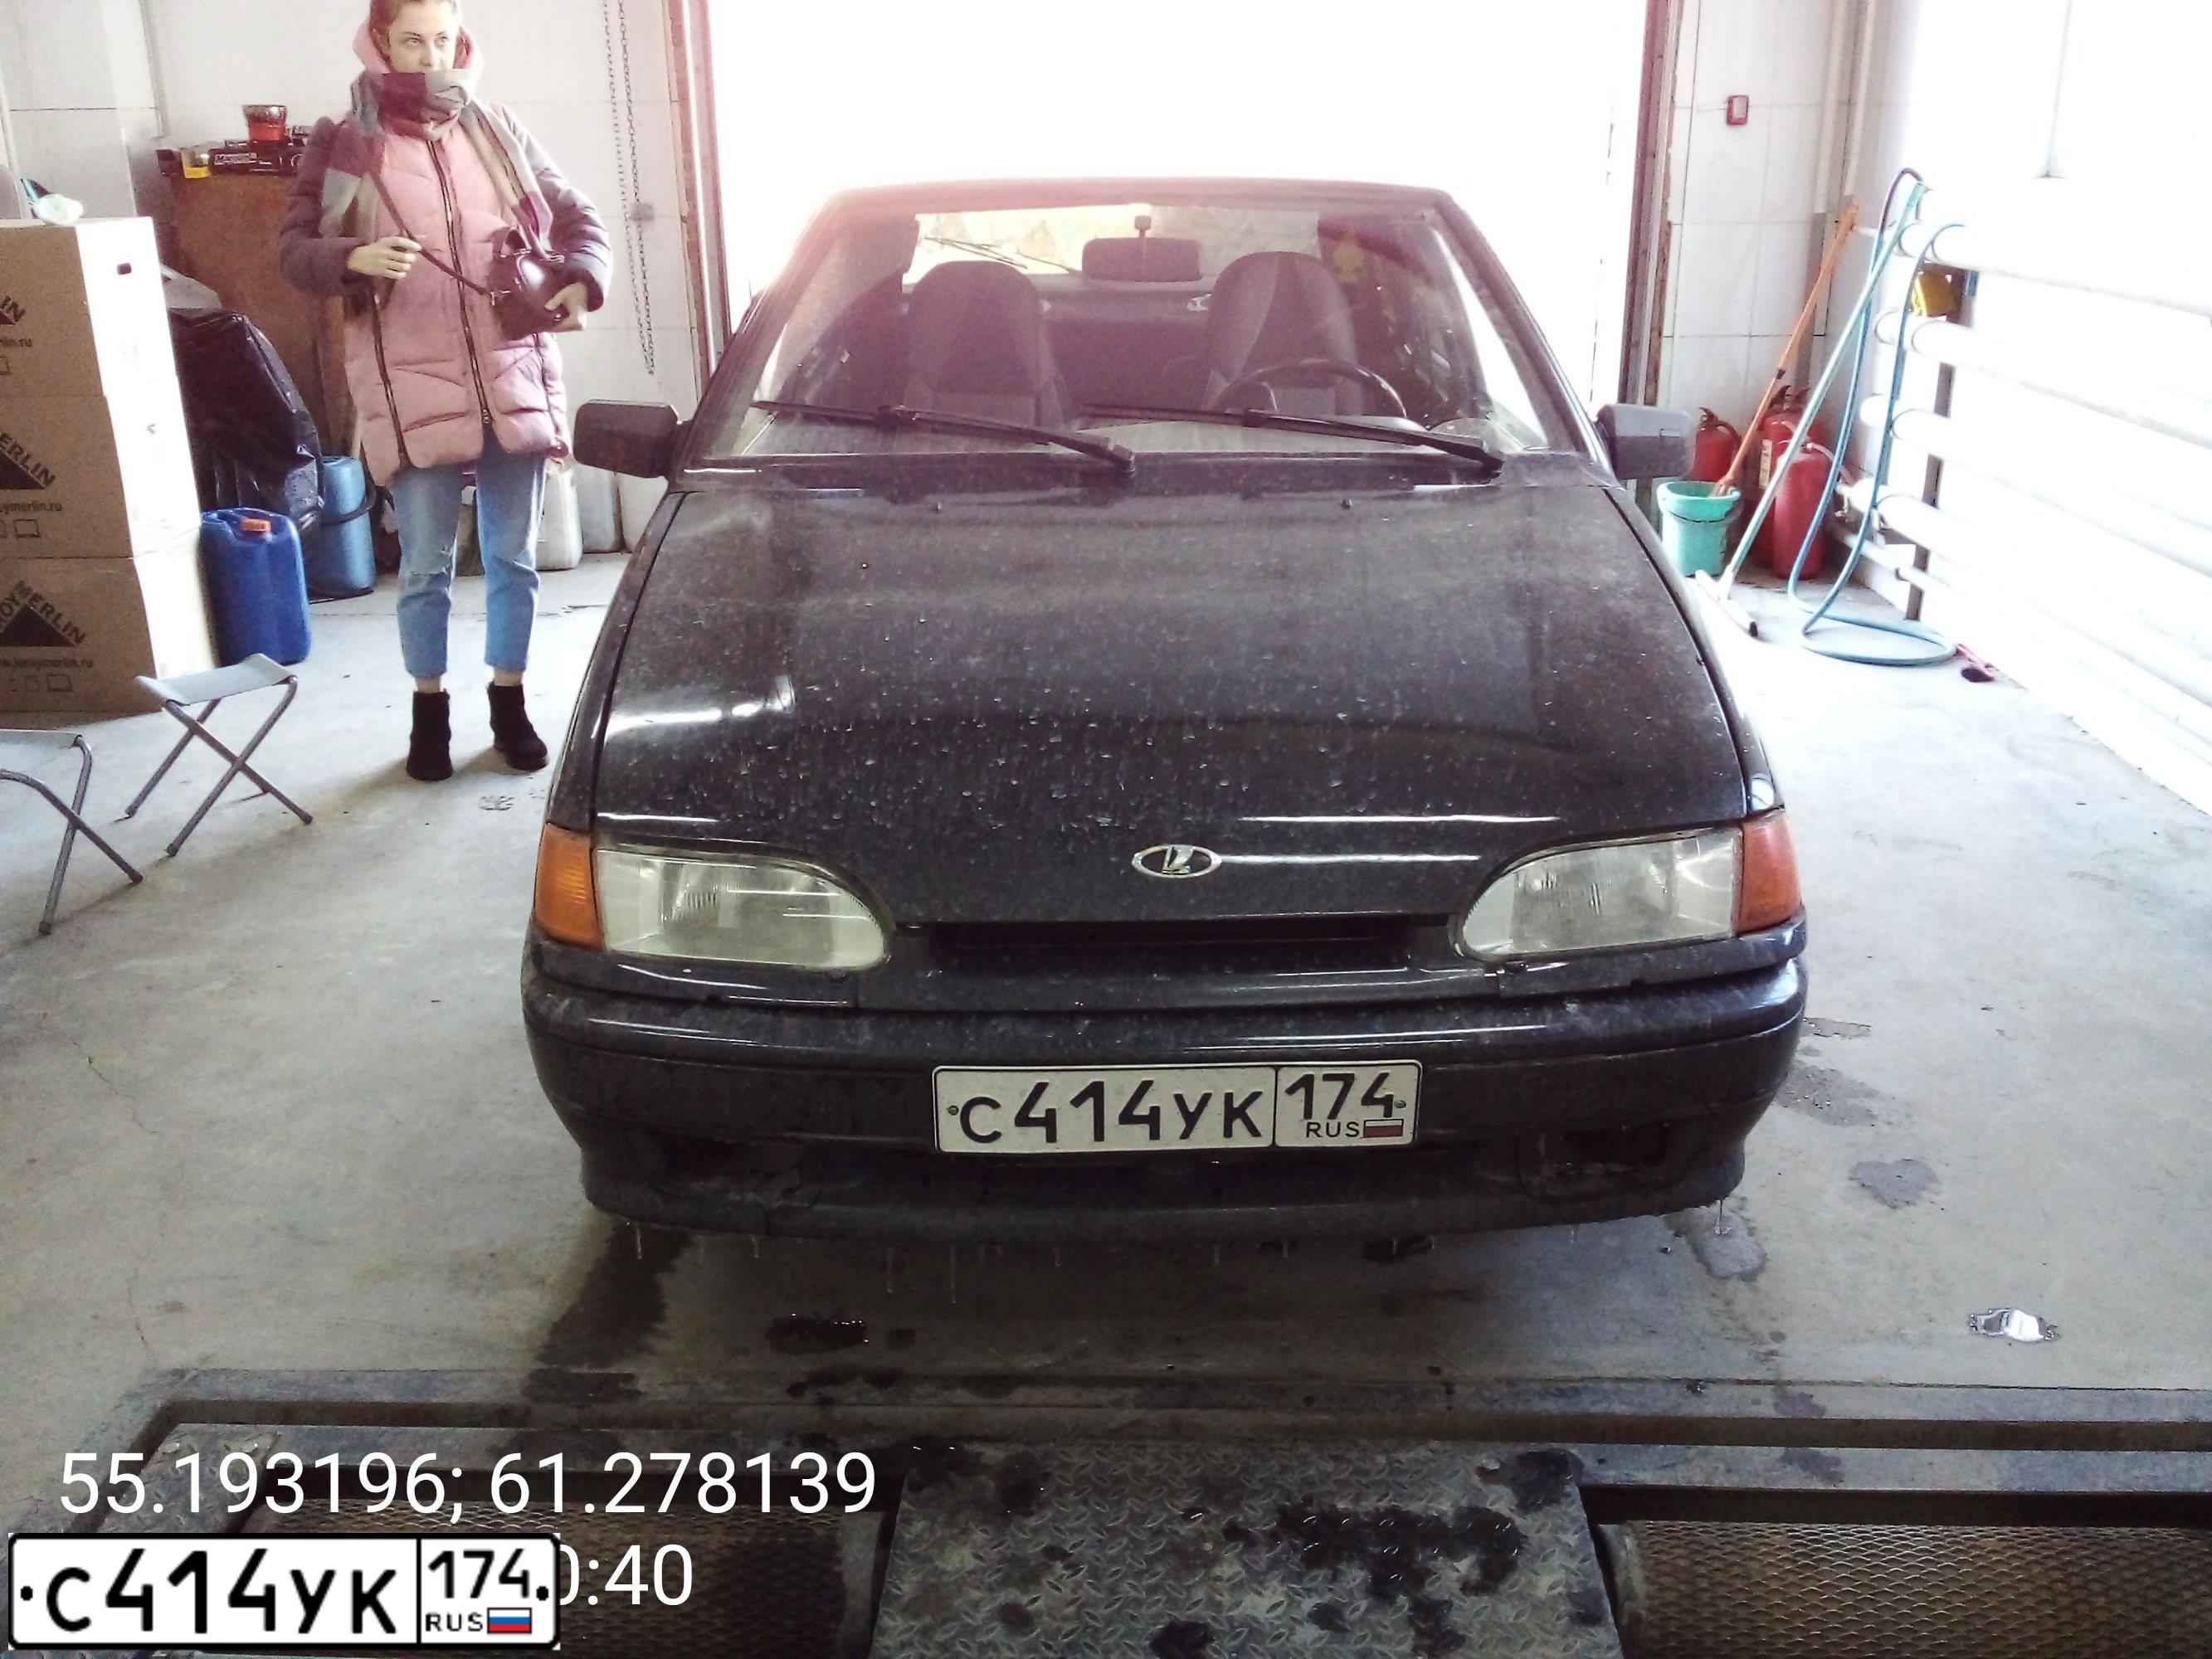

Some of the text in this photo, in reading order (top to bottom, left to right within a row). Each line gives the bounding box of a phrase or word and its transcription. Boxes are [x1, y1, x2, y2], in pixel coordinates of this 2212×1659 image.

[959, 1072, 1395, 1144] С414УК 174
[1306, 1121, 1361, 1139] RUS
